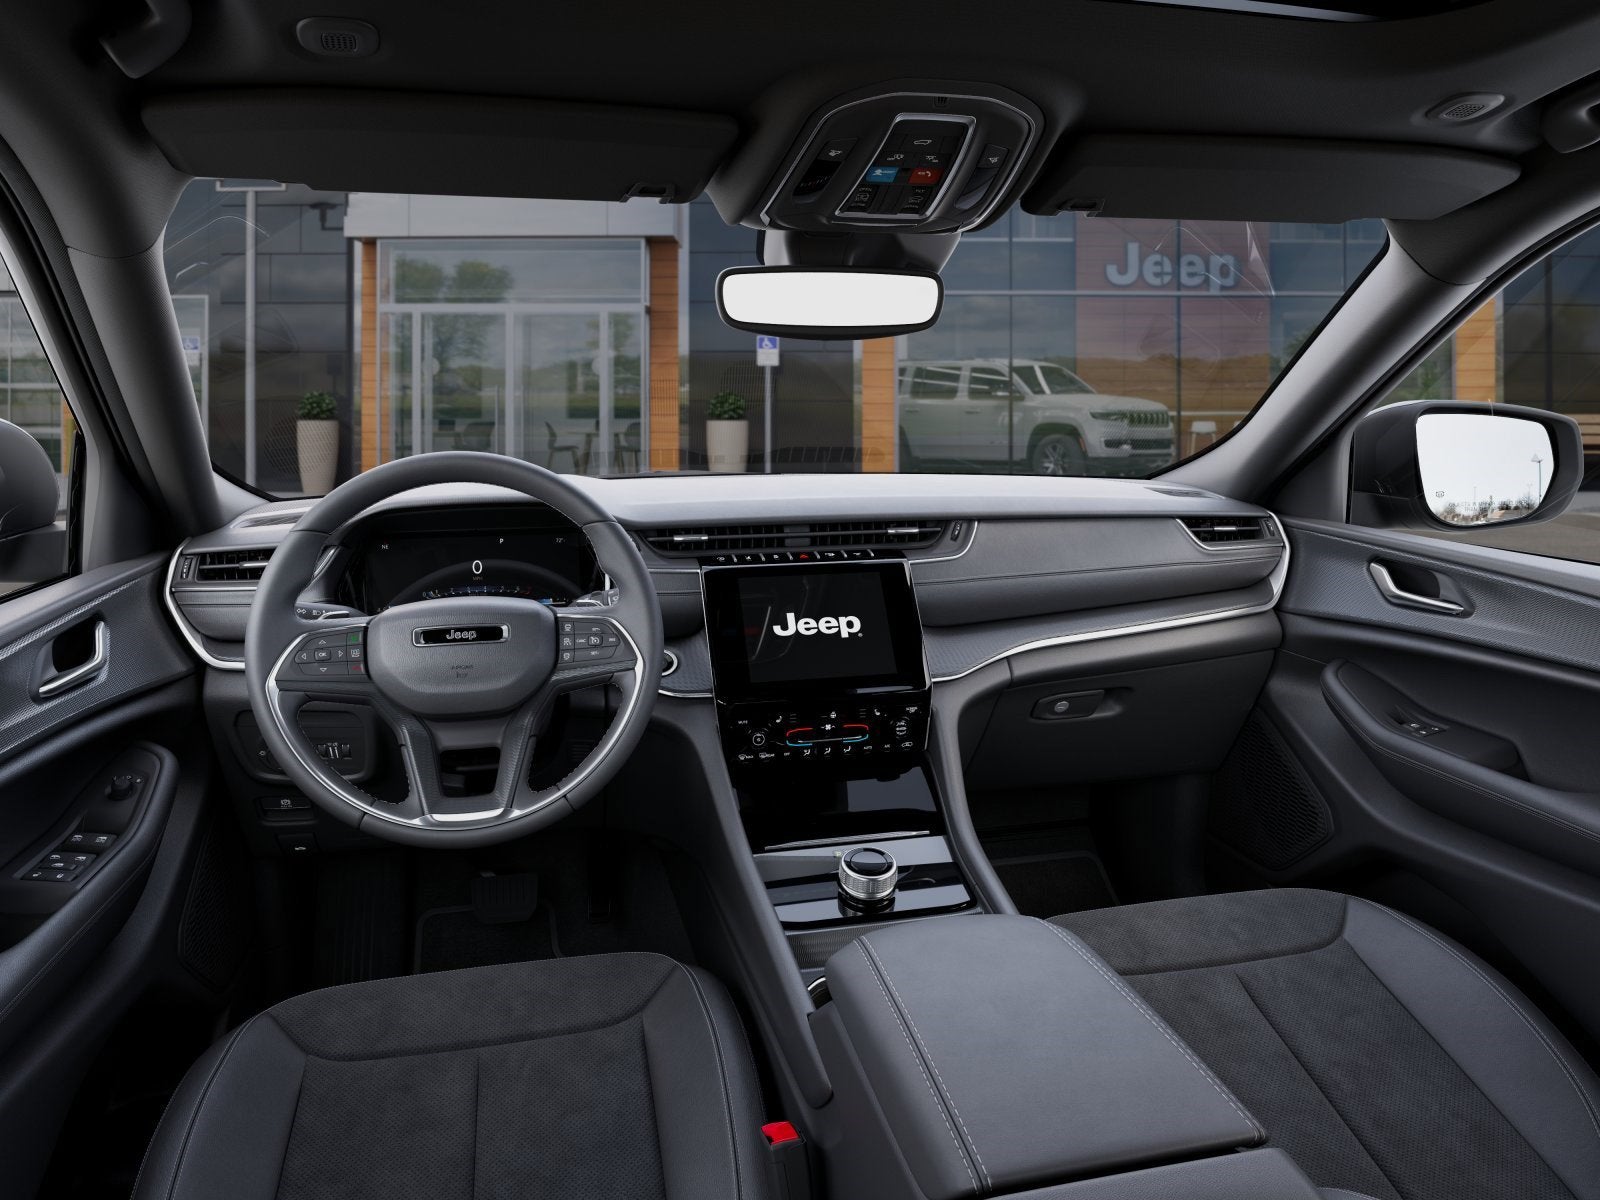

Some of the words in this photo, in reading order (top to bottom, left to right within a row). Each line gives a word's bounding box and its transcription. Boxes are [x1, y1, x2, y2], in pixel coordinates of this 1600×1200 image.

[1105, 241, 1239, 295] Jeep
[472, 559, 483, 574] 0
[445, 629, 477, 640] Jeep
[772, 612, 862, 639] Jeep
